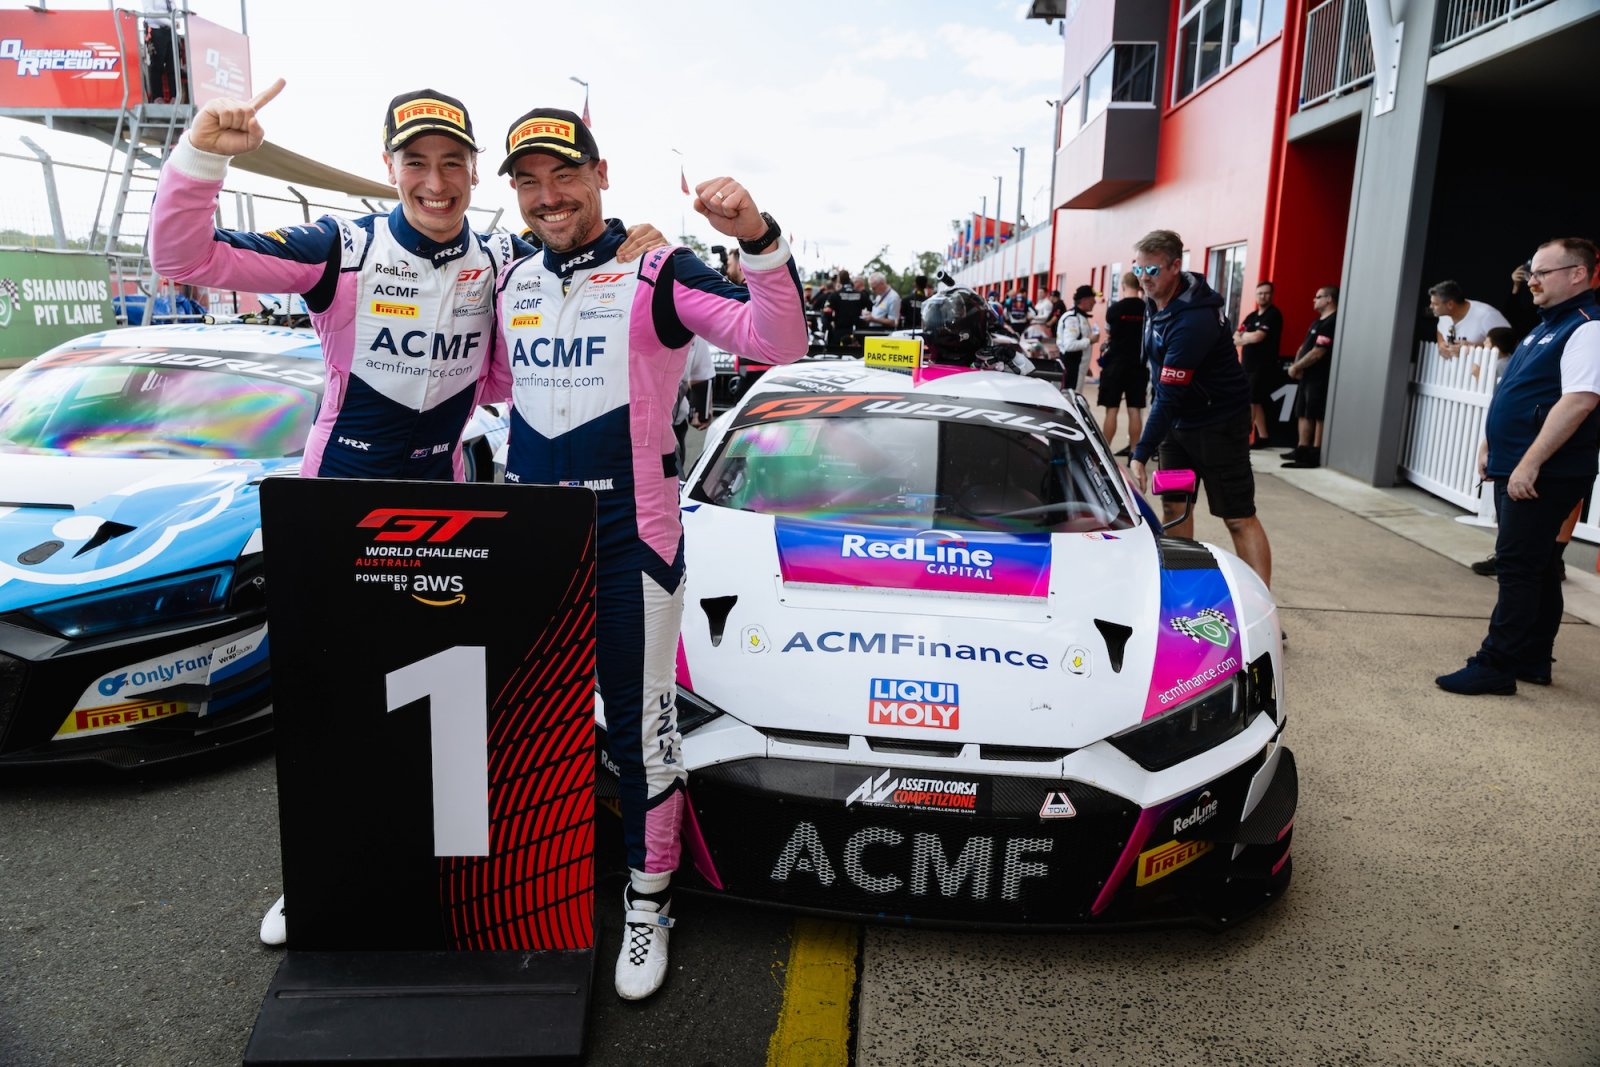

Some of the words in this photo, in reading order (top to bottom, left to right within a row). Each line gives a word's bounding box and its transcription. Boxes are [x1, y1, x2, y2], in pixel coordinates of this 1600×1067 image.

[0, 39, 93, 60] QUEENSLAND
[17, 57, 118, 76] RACEWAY
[397, 102, 462, 124] PIRELLI
[511, 121, 571, 149] PIRELLI
[375, 263, 419, 279] RedLine
[560, 250, 596, 272] HRX
[22, 278, 108, 302] SHANNONS
[373, 284, 419, 298] ACMF
[515, 280, 541, 292] RedLine
[35, 305, 60, 325] PIT
[64, 303, 103, 325] LANE
[375, 303, 416, 316] PIRELLI
[513, 298, 543, 310] ACMF
[512, 316, 539, 327] PIRELLI
[369, 327, 482, 361] ACMF
[512, 336, 606, 367] ACMF
[867, 352, 887, 361] PARC
[888, 354, 914, 363] FERME
[120, 352, 324, 385] WORLD
[365, 359, 473, 379] acmfinance.com
[1161, 367, 1186, 379] SRO
[745, 394, 905, 420] GT
[861, 400, 1086, 442] WORLD
[338, 435, 371, 451] HRX
[505, 470, 520, 483] HRX
[584, 478, 614, 490] MARK
[355, 508, 508, 543] GT
[365, 546, 413, 557] WORLD
[415, 547, 489, 559] CHALLENGE
[841, 533, 994, 568] RedLine
[355, 558, 422, 567] AUSTRALIA
[926, 562, 994, 580] CAPITAL
[355, 573, 408, 583] POWERED
[394, 583, 408, 591] BY
[413, 574, 464, 592] aws
[781, 630, 1049, 670] ACMFinance
[131, 652, 213, 687] OnlyFans
[1158, 656, 1238, 705] acmfinance.com
[873, 679, 956, 704] LIQUI
[76, 700, 177, 731] PIRELLI
[872, 701, 958, 728] MOLY
[385, 646, 489, 857] 1
[899, 777, 945, 793] ASSETTO
[943, 779, 977, 796] CORSA
[893, 790, 976, 809] COMPETIZIONE
[1173, 799, 1218, 835] RedLine
[770, 821, 1054, 901] ACMF
[1144, 839, 1209, 878] PIRELLI
